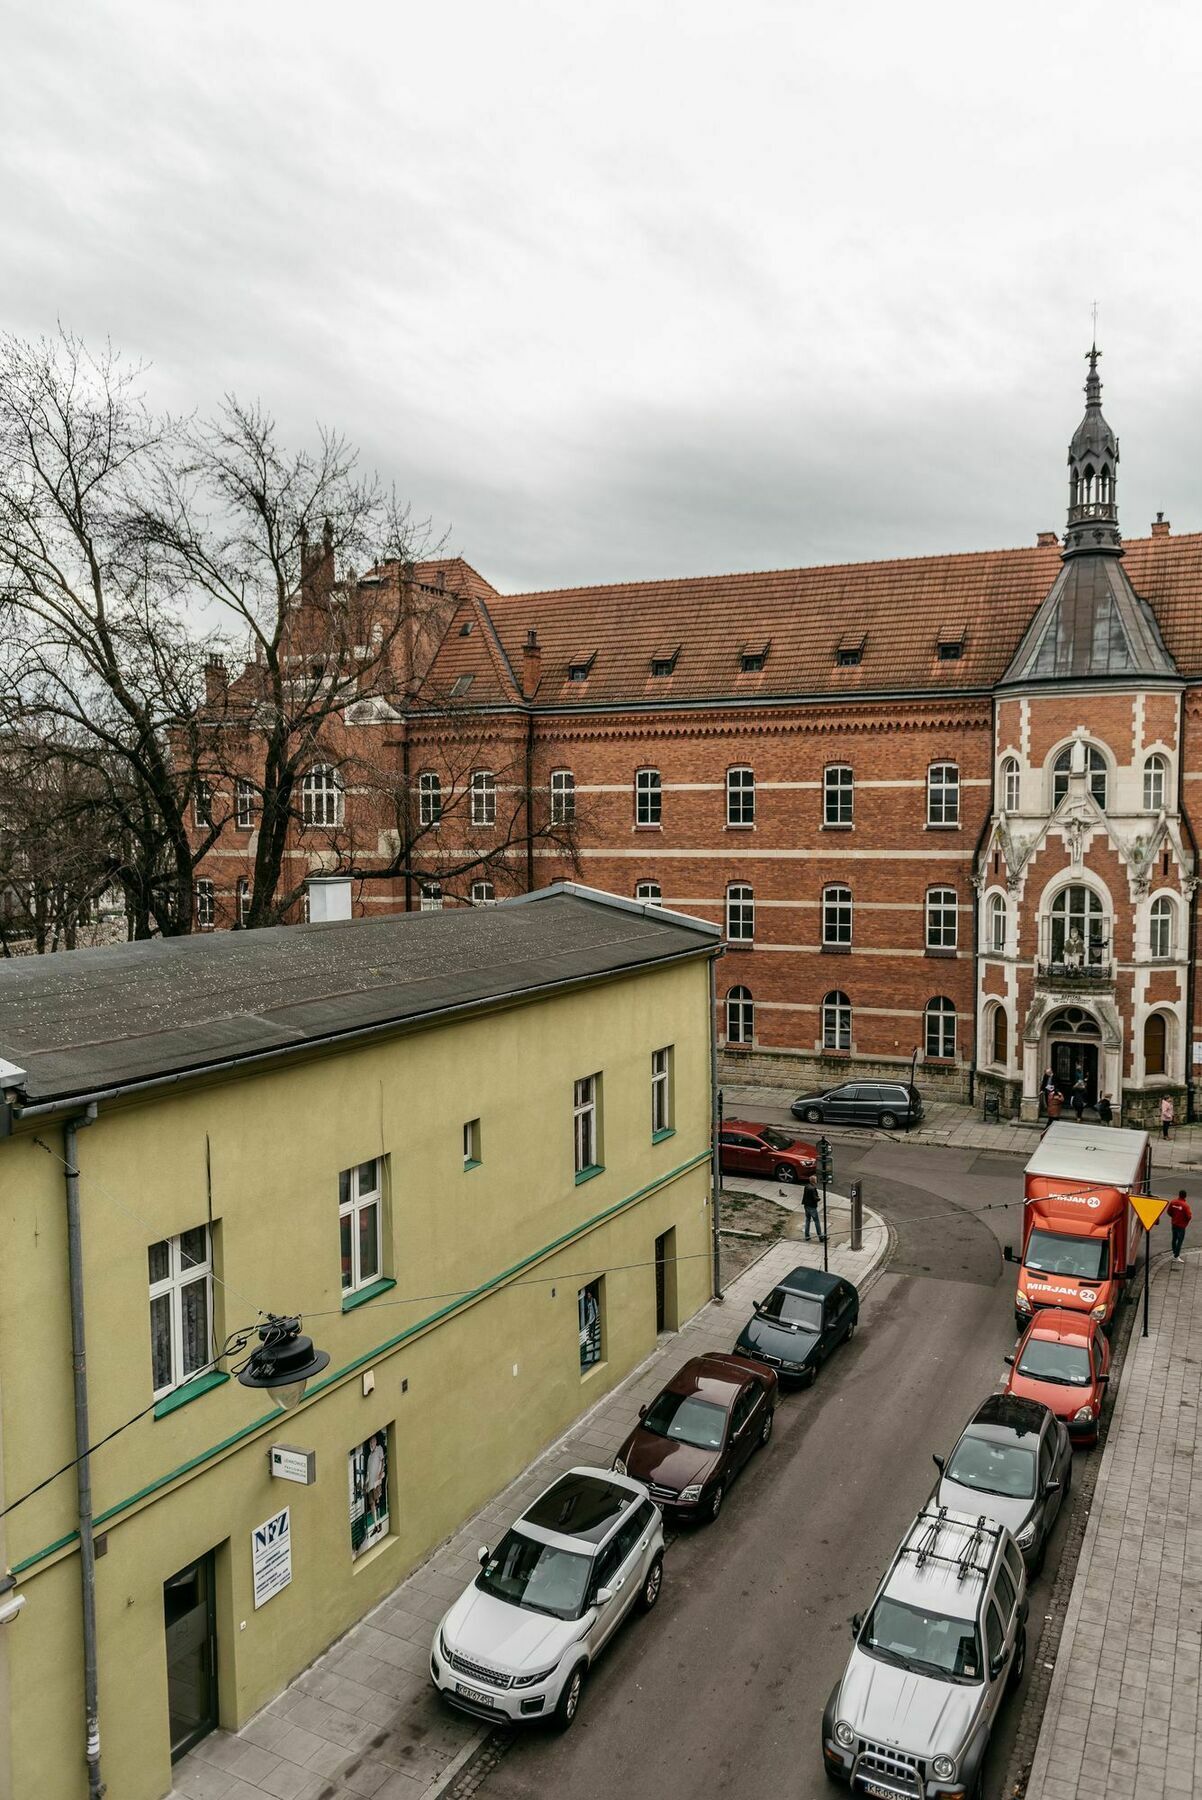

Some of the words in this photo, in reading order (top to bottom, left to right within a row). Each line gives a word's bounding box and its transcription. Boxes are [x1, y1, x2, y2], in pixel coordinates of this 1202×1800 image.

[1026, 1283, 1078, 1296] MIRJAN
[1082, 1291, 1095, 1300] 24
[255, 1511, 289, 1553] NFZ
